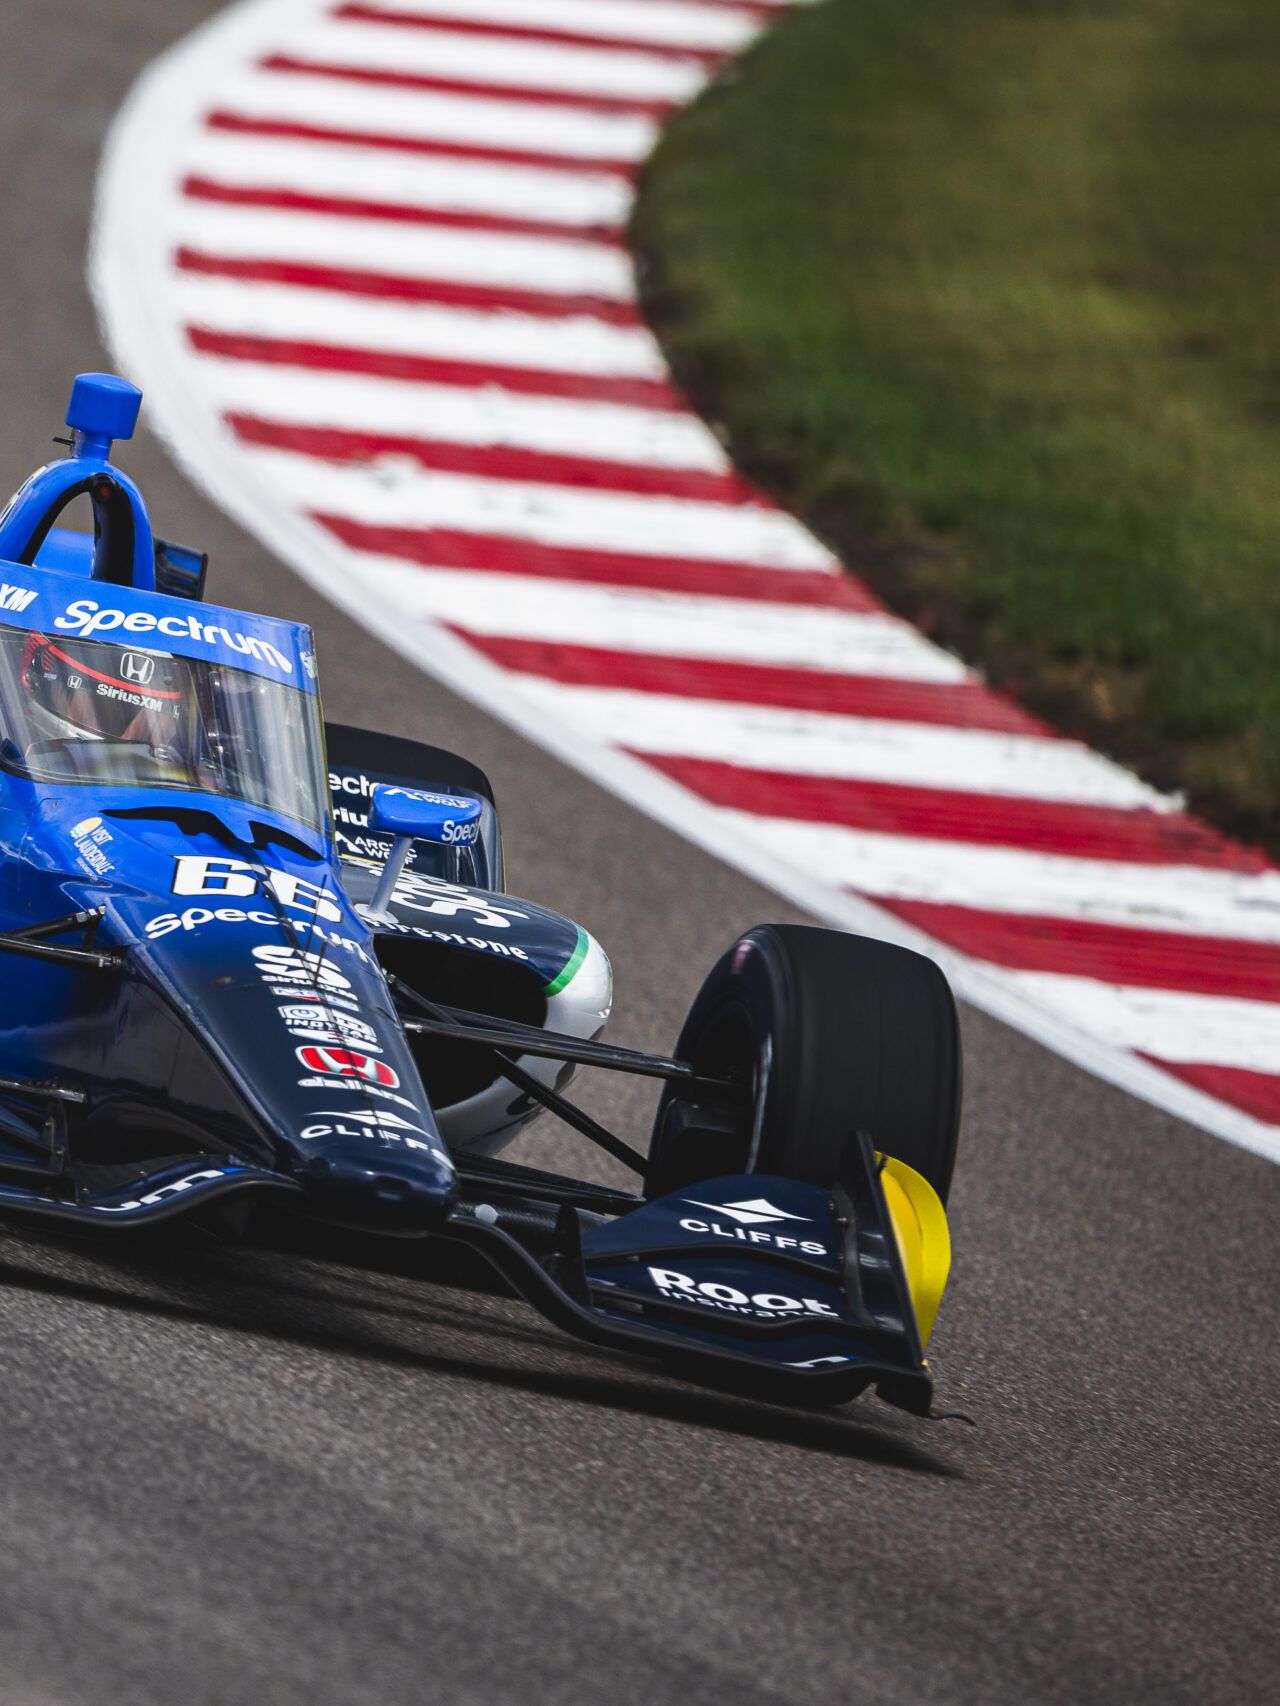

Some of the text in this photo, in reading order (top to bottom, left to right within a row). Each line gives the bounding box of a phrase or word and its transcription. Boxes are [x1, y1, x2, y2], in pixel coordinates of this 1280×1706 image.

[53, 600, 293, 674] Spectrum
[96, 683, 163, 713] SiriusXM
[74, 834, 116, 876] LAUDERDALE
[91, 825, 114, 846] VISIT
[171, 855, 343, 923] 66
[679, 1218, 828, 1256] CLIFFS
